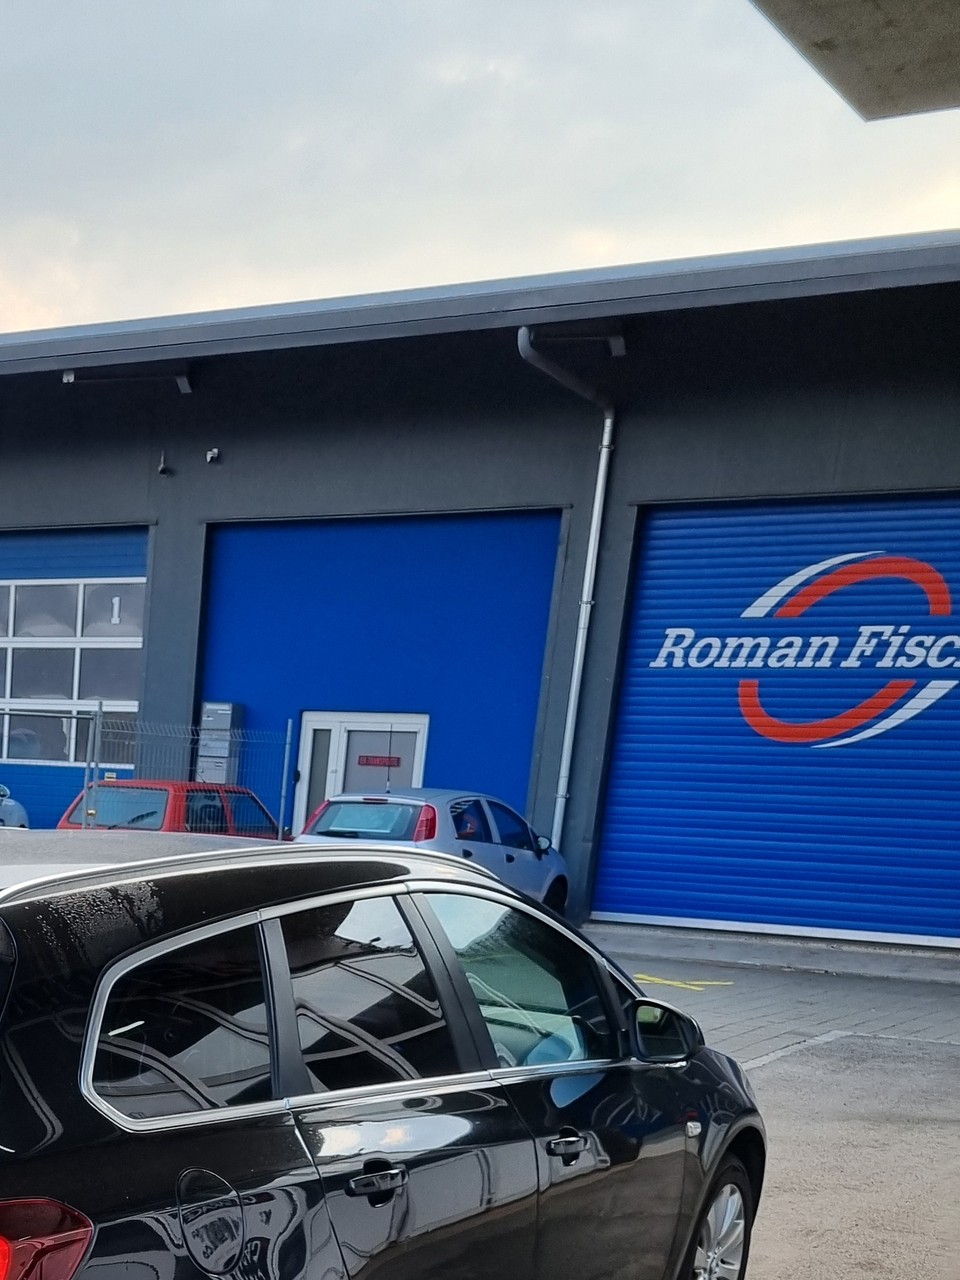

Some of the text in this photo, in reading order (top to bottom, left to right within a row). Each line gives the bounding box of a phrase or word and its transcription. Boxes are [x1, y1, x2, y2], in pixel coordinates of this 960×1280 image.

[111, 596, 121, 624] 1
[649, 625, 960, 669] Roman Fisc
